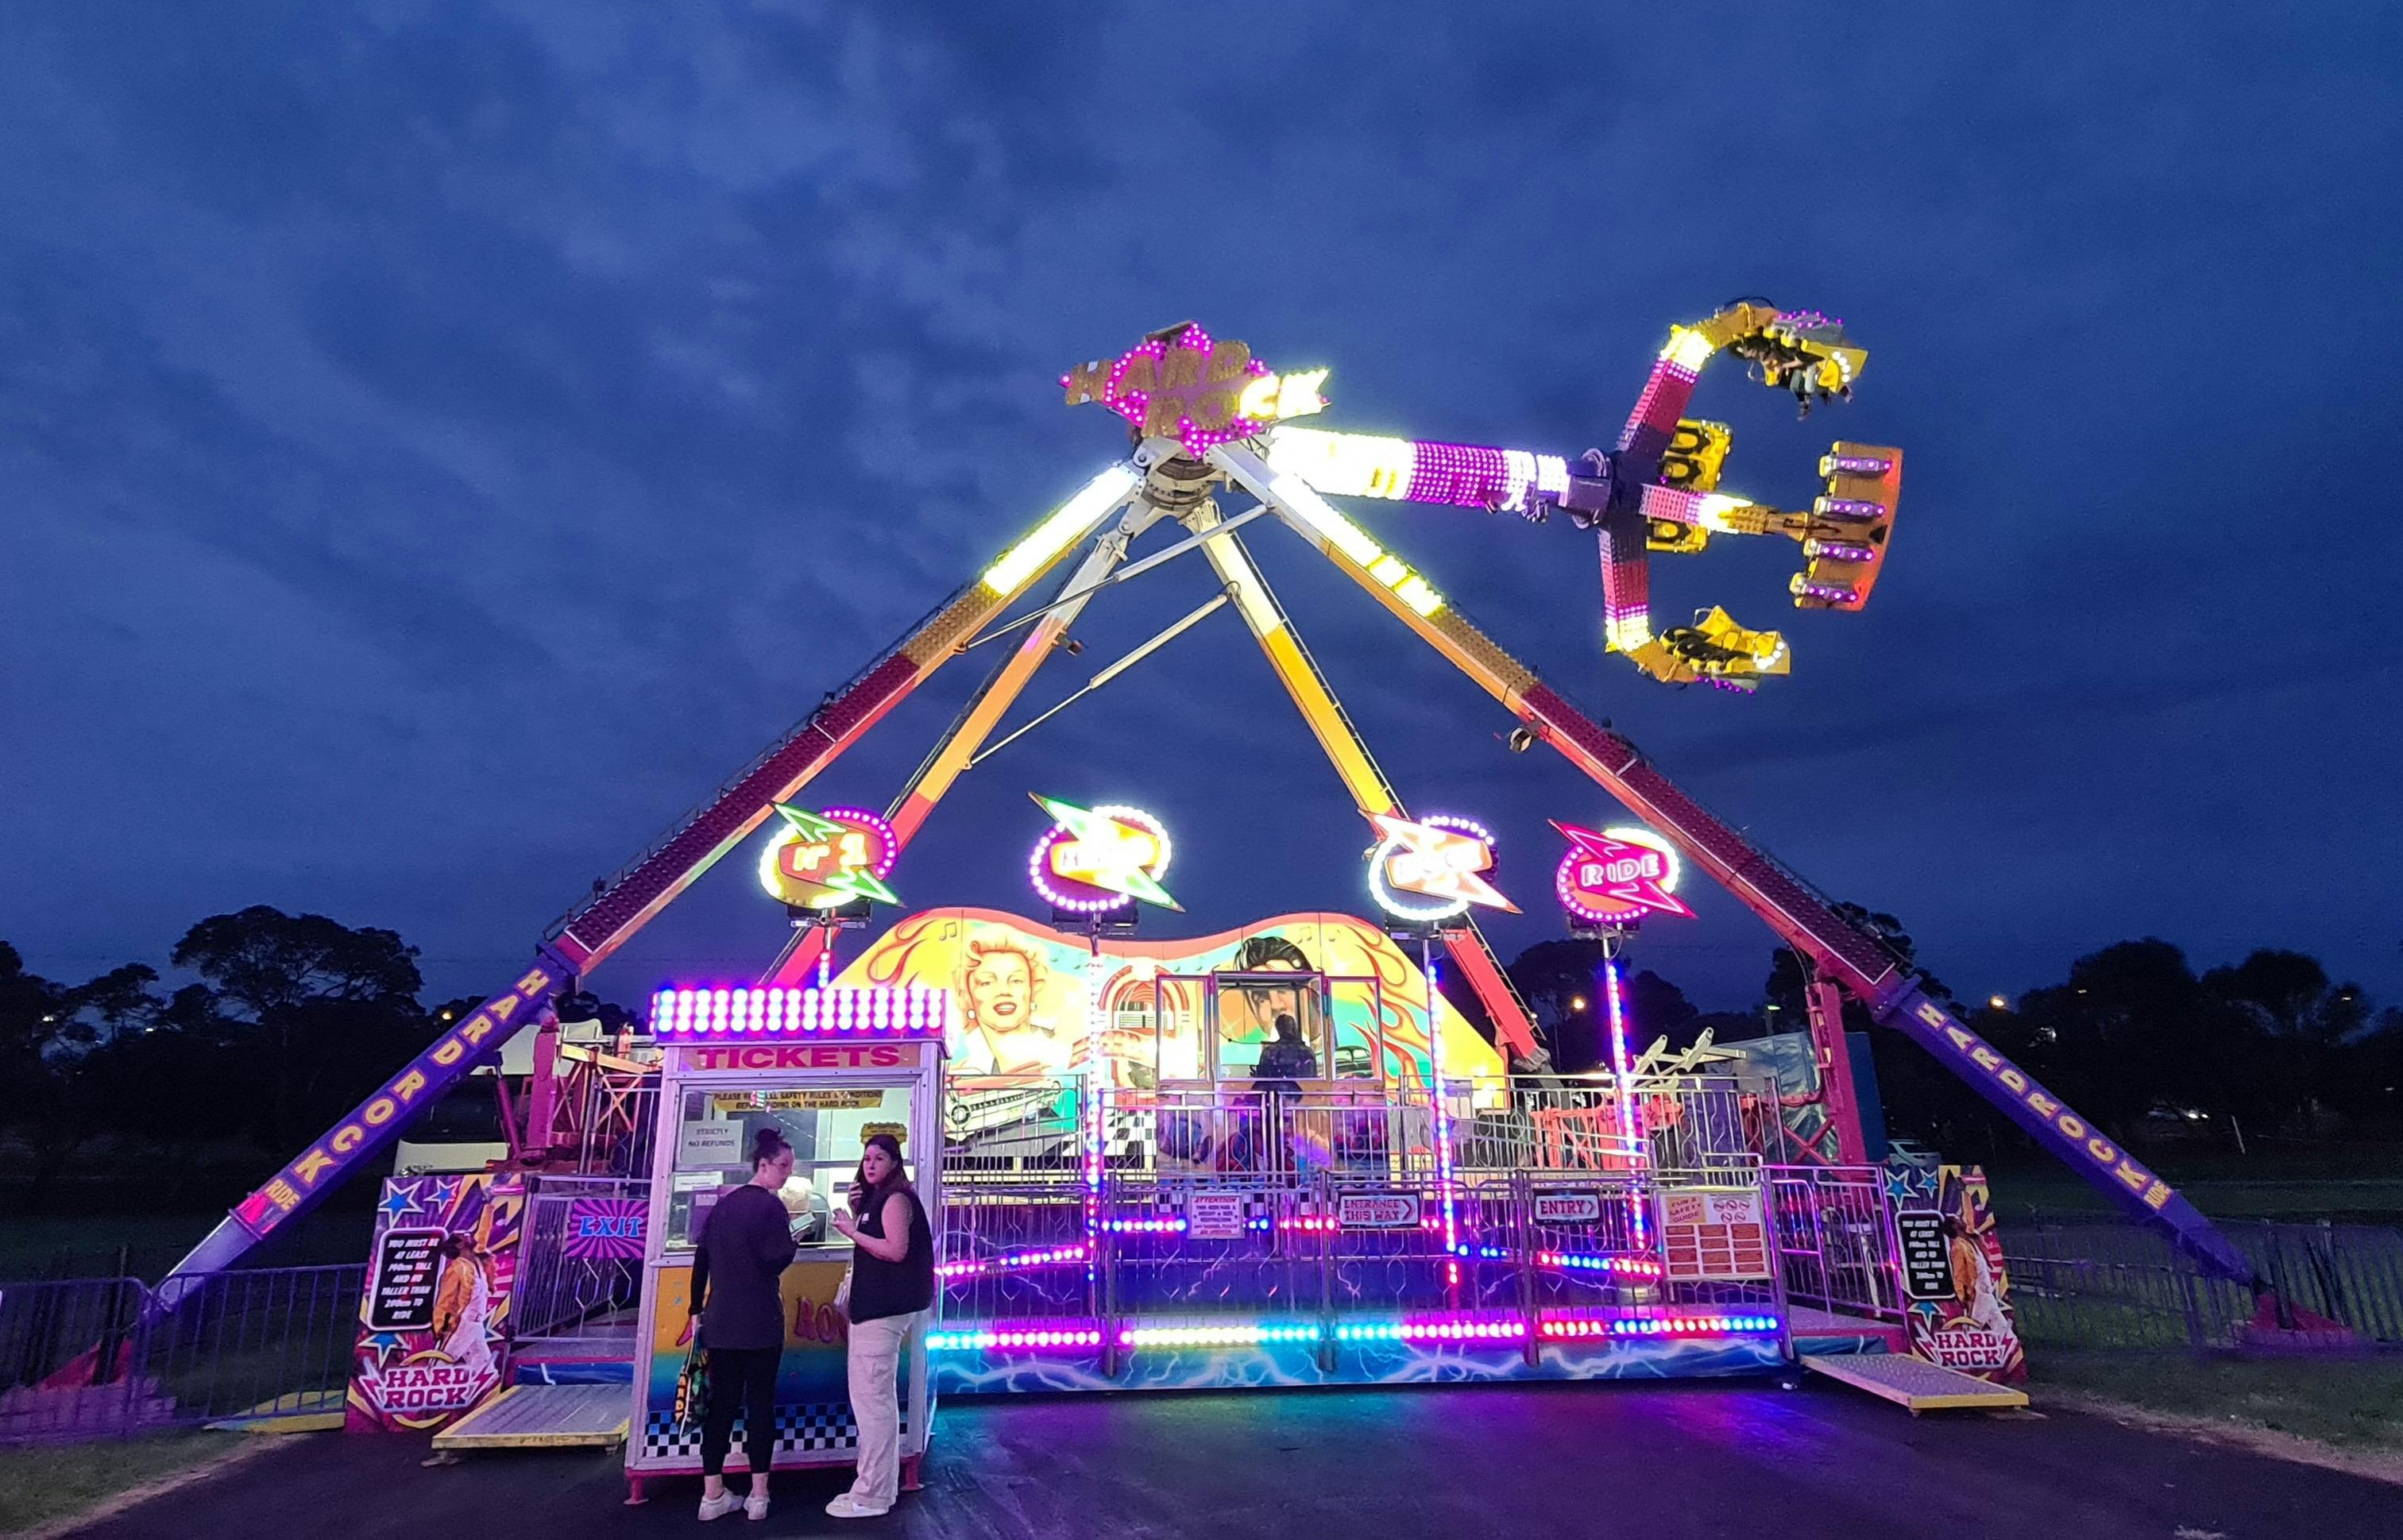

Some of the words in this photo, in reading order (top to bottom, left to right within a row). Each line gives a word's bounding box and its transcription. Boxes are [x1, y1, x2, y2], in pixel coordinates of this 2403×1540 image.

[1581, 854, 1660, 887] RIDE
[432, 969, 551, 1066] HARD
[697, 1046, 900, 1070] TICKETS
[1917, 1002, 2026, 1093] HARD
[2027, 1092, 2146, 1190] ROCK
[295, 1069, 426, 1185] ROCK
[265, 1179, 300, 1211] RIDE
[1344, 1199, 1399, 1208] ENTRANCE
[1345, 1211, 1370, 1221] THIS
[1374, 1210, 1399, 1221] WAY
[1540, 1199, 1586, 1214] ENTRY
[1673, 1211, 1699, 1223] GUIDE
[578, 1216, 643, 1237] EXIT
[1937, 1333, 1997, 1349] HARD
[1940, 1349, 2000, 1367] ROCK
[386, 1368, 469, 1388] HARD
[384, 1387, 467, 1409] ROCK
